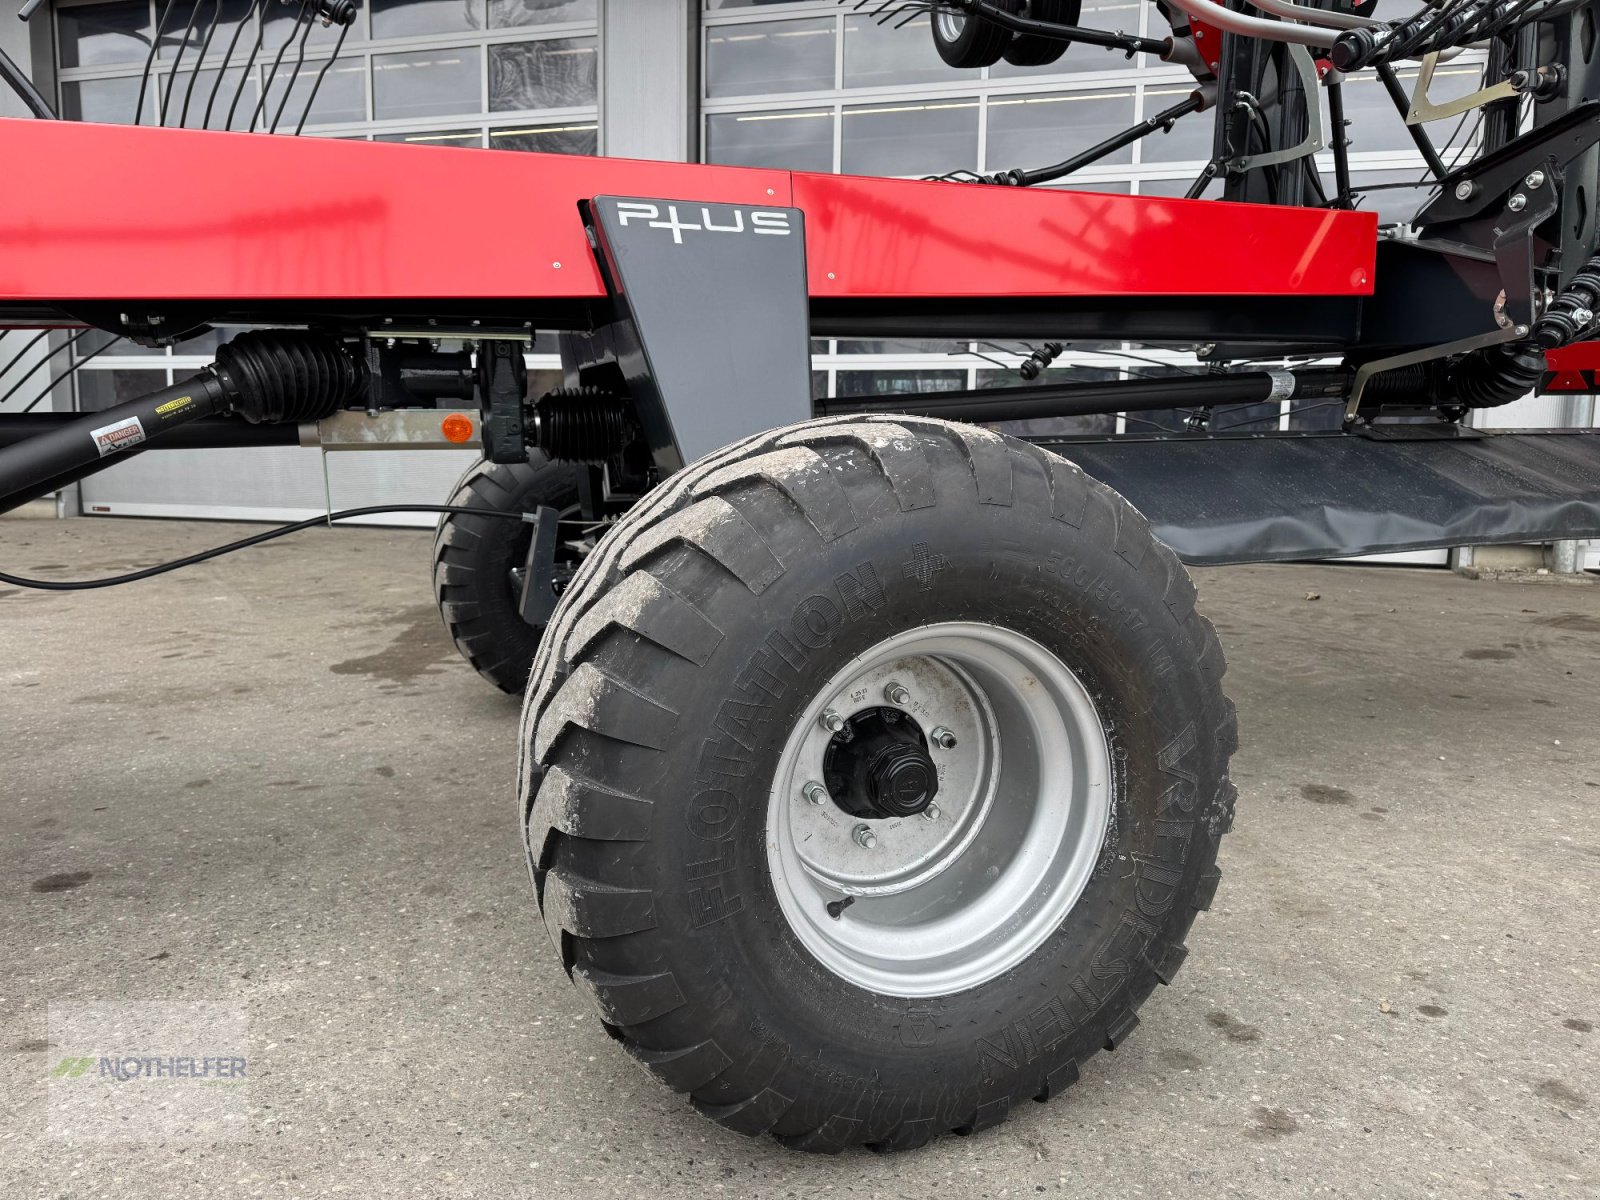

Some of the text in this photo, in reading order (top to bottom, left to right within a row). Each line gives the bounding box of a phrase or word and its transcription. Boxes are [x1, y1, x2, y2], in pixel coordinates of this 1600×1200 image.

[109, 425, 139, 442] DANGER
[686, 561, 887, 929] FLOTATION
[975, 721, 1198, 1085] VREDESTEIN
